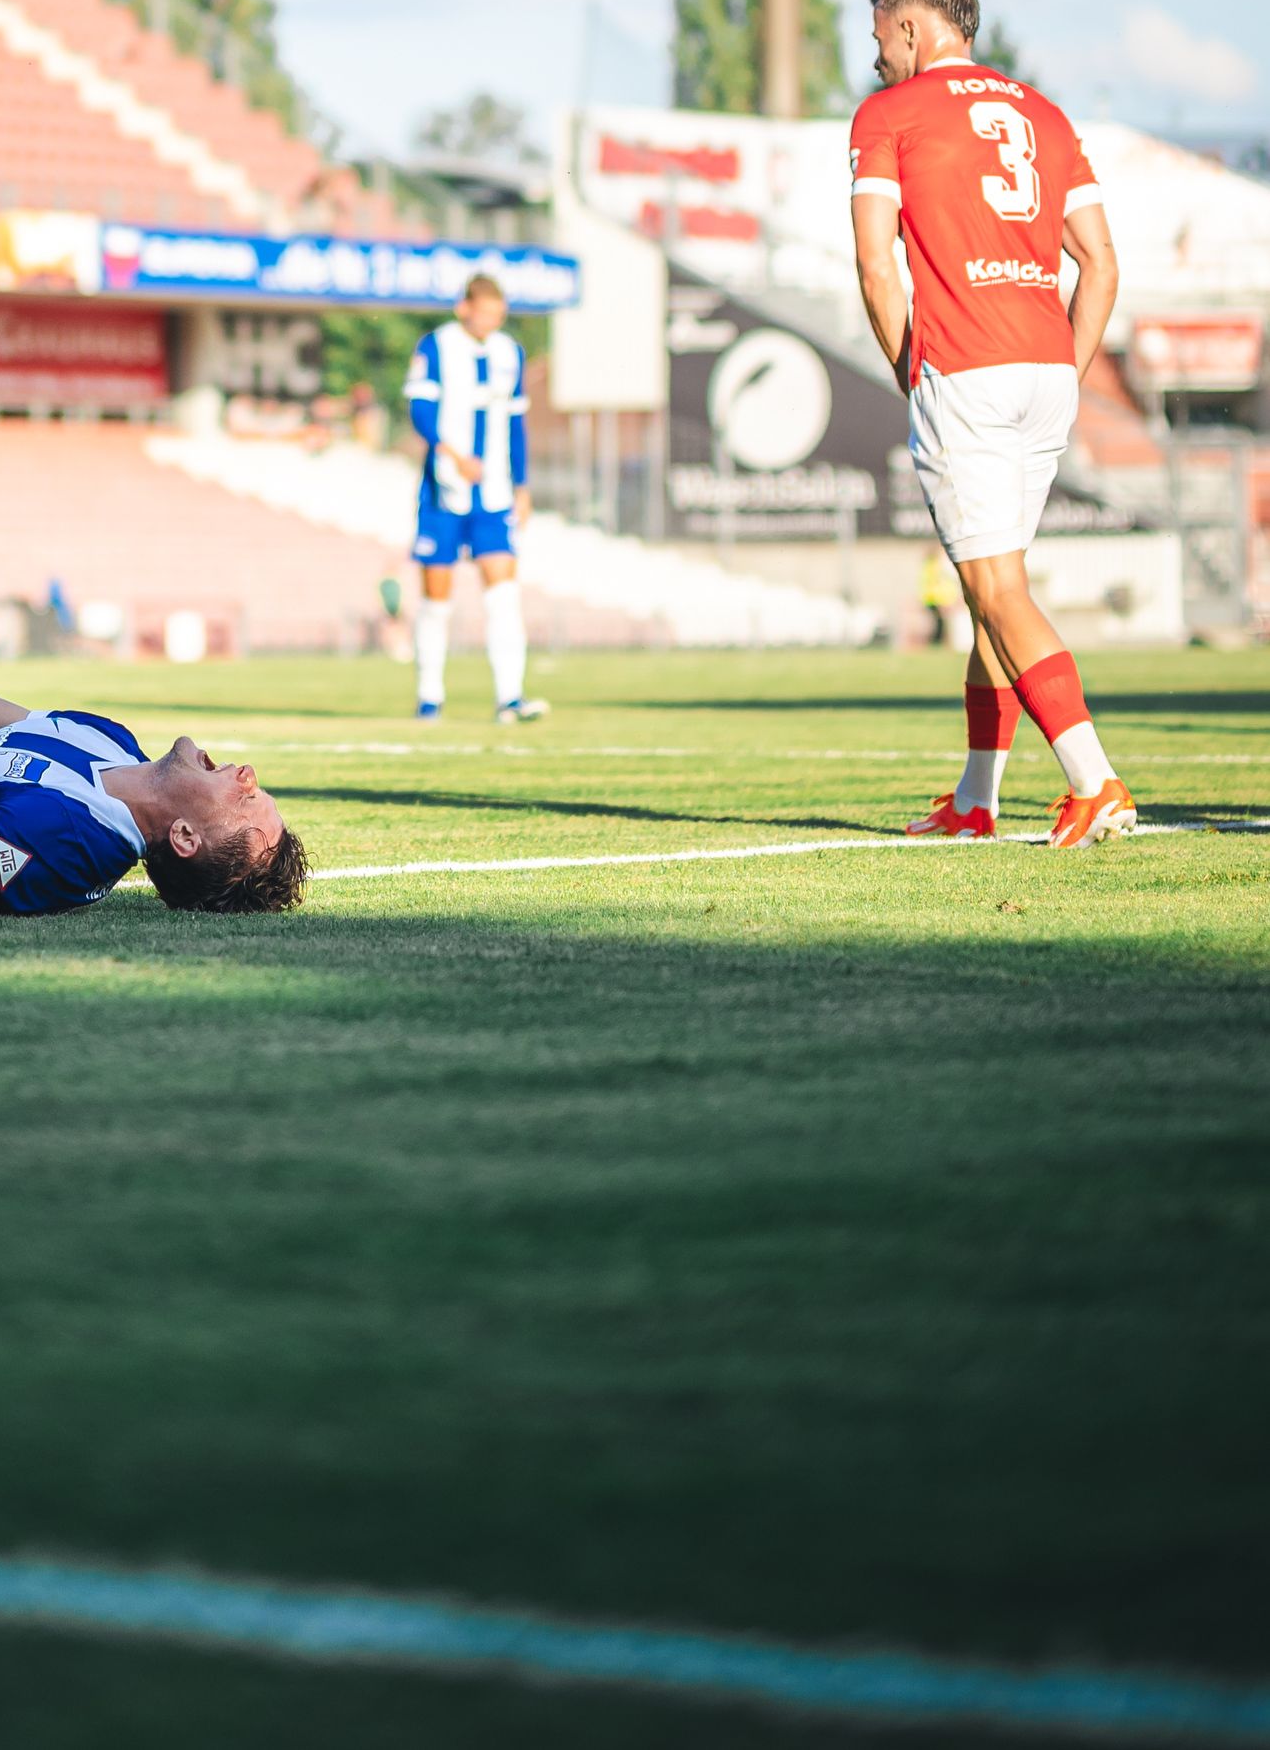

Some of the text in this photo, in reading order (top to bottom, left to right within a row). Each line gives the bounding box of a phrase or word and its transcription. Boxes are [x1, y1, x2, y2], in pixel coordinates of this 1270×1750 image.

[947, 78, 1024, 99] RORIG
[968, 102, 1040, 223] 3
[0, 848, 18, 873] WTG
